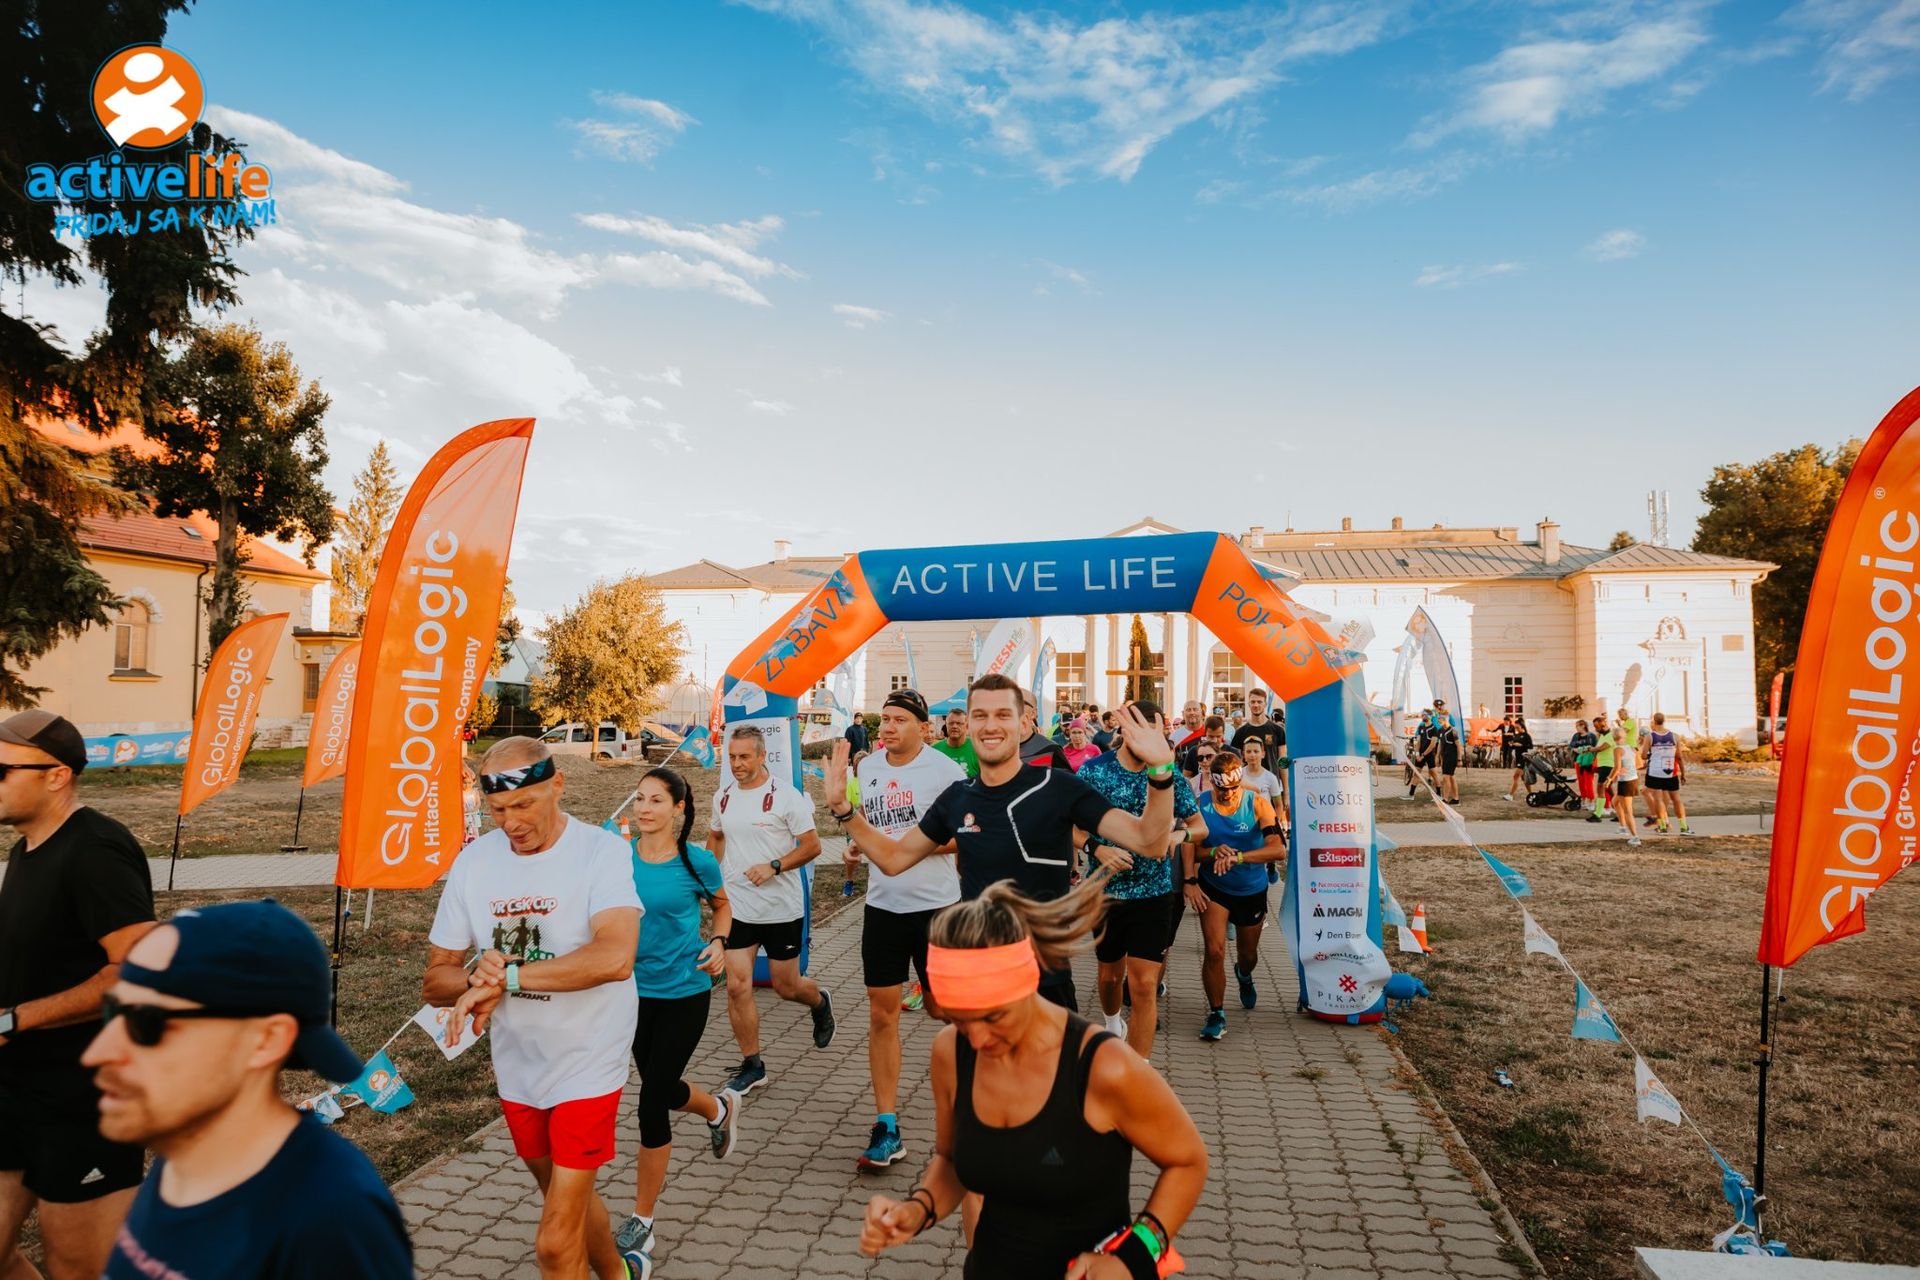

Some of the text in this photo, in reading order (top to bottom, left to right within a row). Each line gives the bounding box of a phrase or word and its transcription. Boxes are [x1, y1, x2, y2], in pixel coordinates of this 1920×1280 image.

[891, 556, 1177, 595] ACTIVE LIFE
[1218, 581, 1314, 667] POHYB
[454, 635, 482, 721] Company
[380, 529, 468, 867] GlobalLogic
[201, 646, 254, 787] GlobalLogic
[320, 662, 357, 767] GlobalLogic
[1302, 763, 1364, 777] GlobalLogic
[423, 781, 441, 847] Hitachi
[864, 790, 914, 814] HALF 2019
[1319, 790, 1365, 807] KOŠICE
[867, 804, 918, 828] MARATHON
[1318, 823, 1357, 833] FRESH
[424, 851, 441, 866] A
[531, 896, 558, 915] Cup
